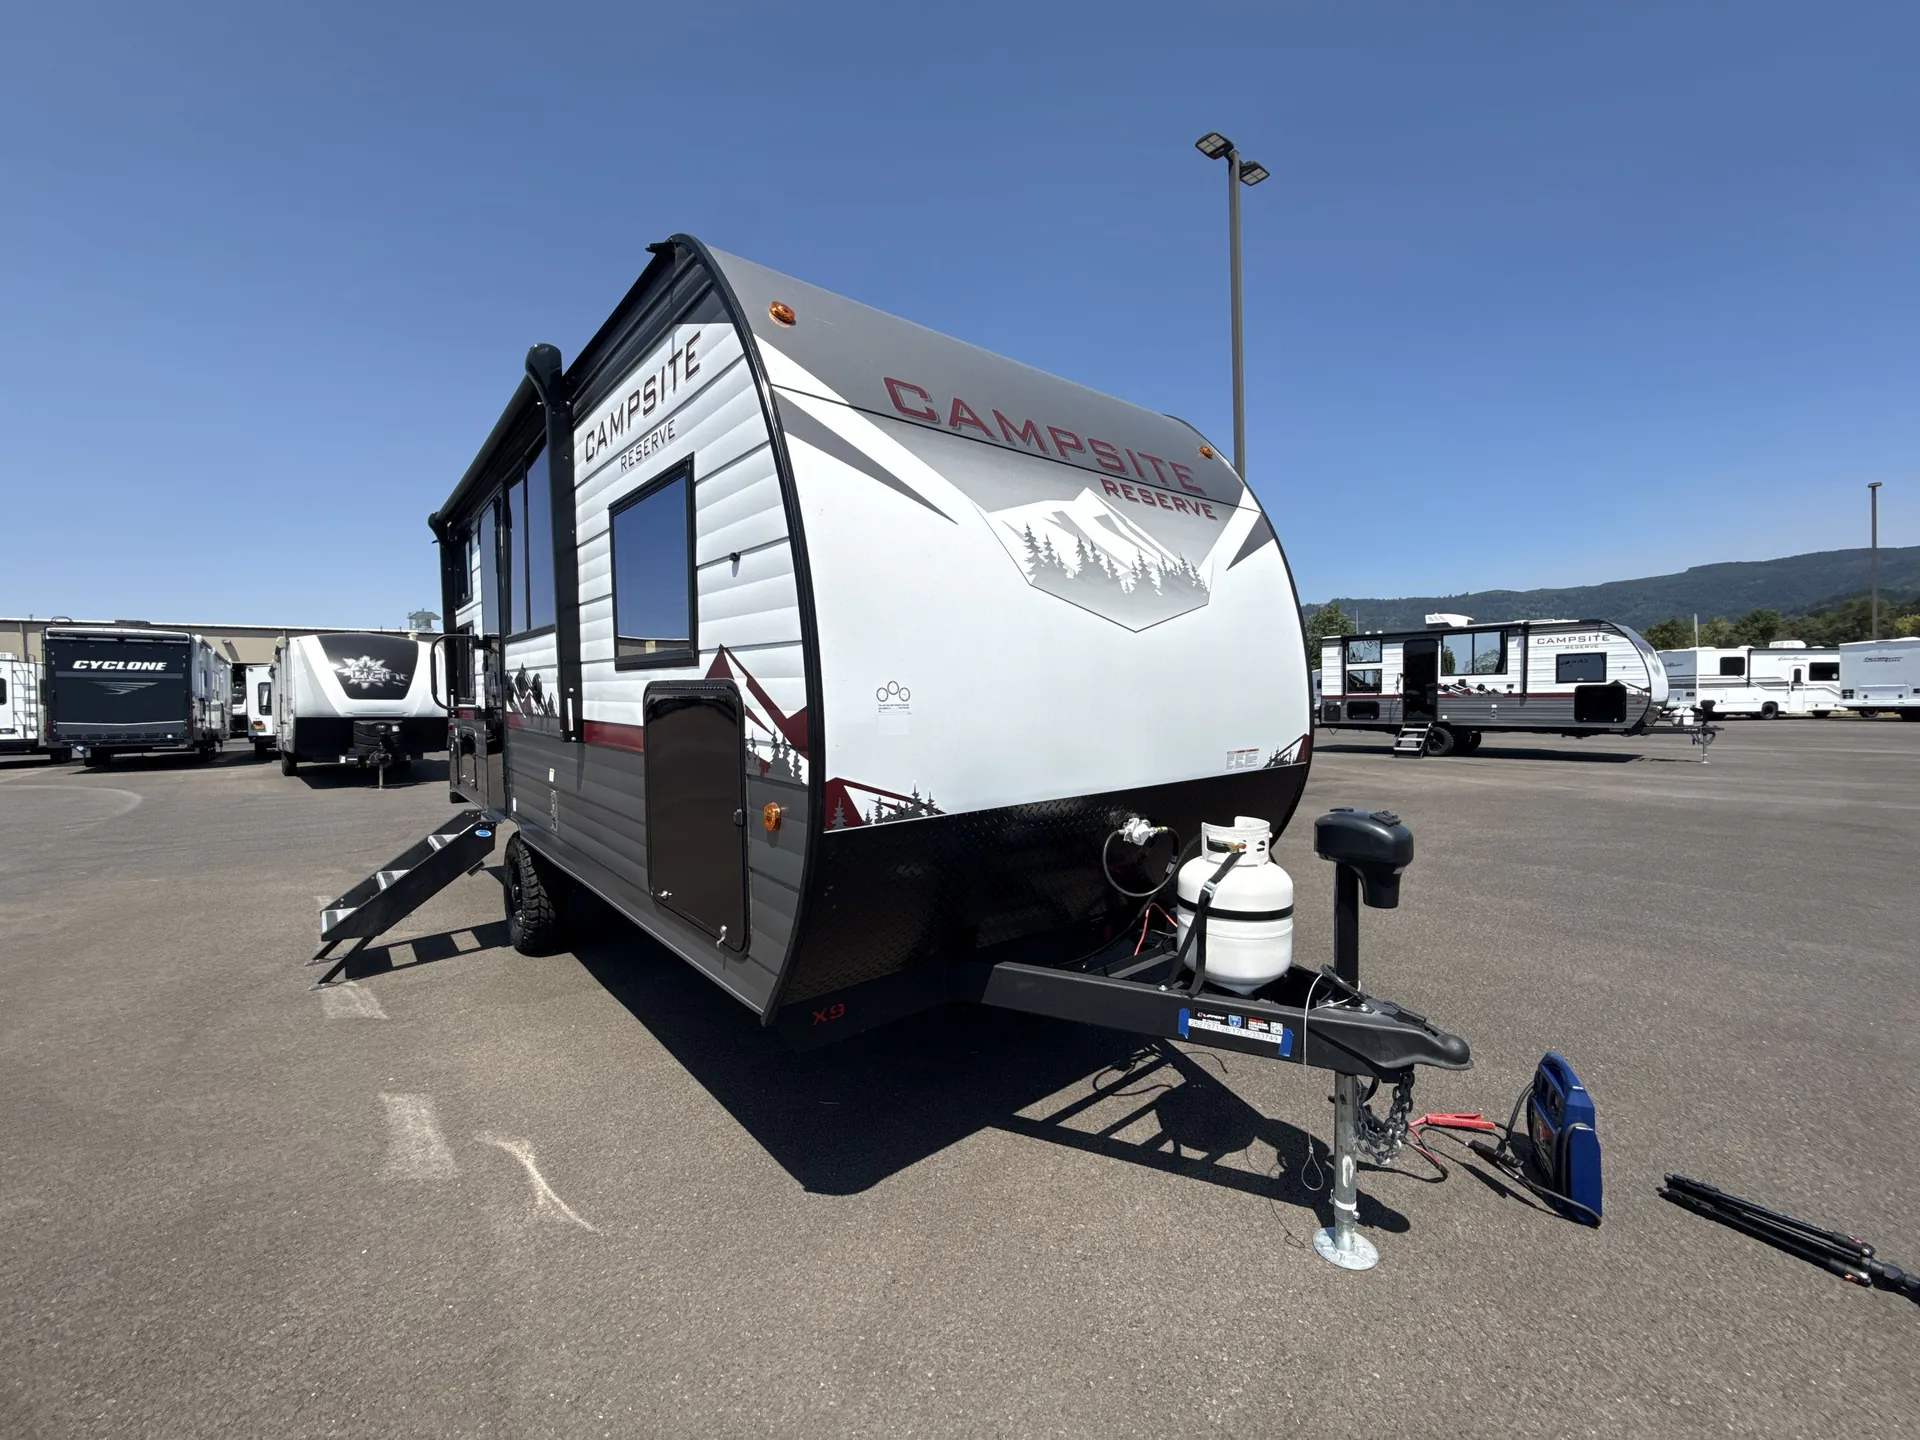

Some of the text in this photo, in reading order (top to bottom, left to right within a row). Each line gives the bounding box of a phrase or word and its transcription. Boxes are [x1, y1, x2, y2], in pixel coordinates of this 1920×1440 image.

[585, 330, 701, 463] CAMPSITE
[620, 419, 676, 472] RESERVE
[883, 376, 1207, 497] CAMPSITE
[1100, 477, 1218, 521] RESERVE
[1536, 634, 1611, 645] CAMPSITE
[72, 660, 168, 671] CYCLONE
[811, 1003, 845, 1026] X9
